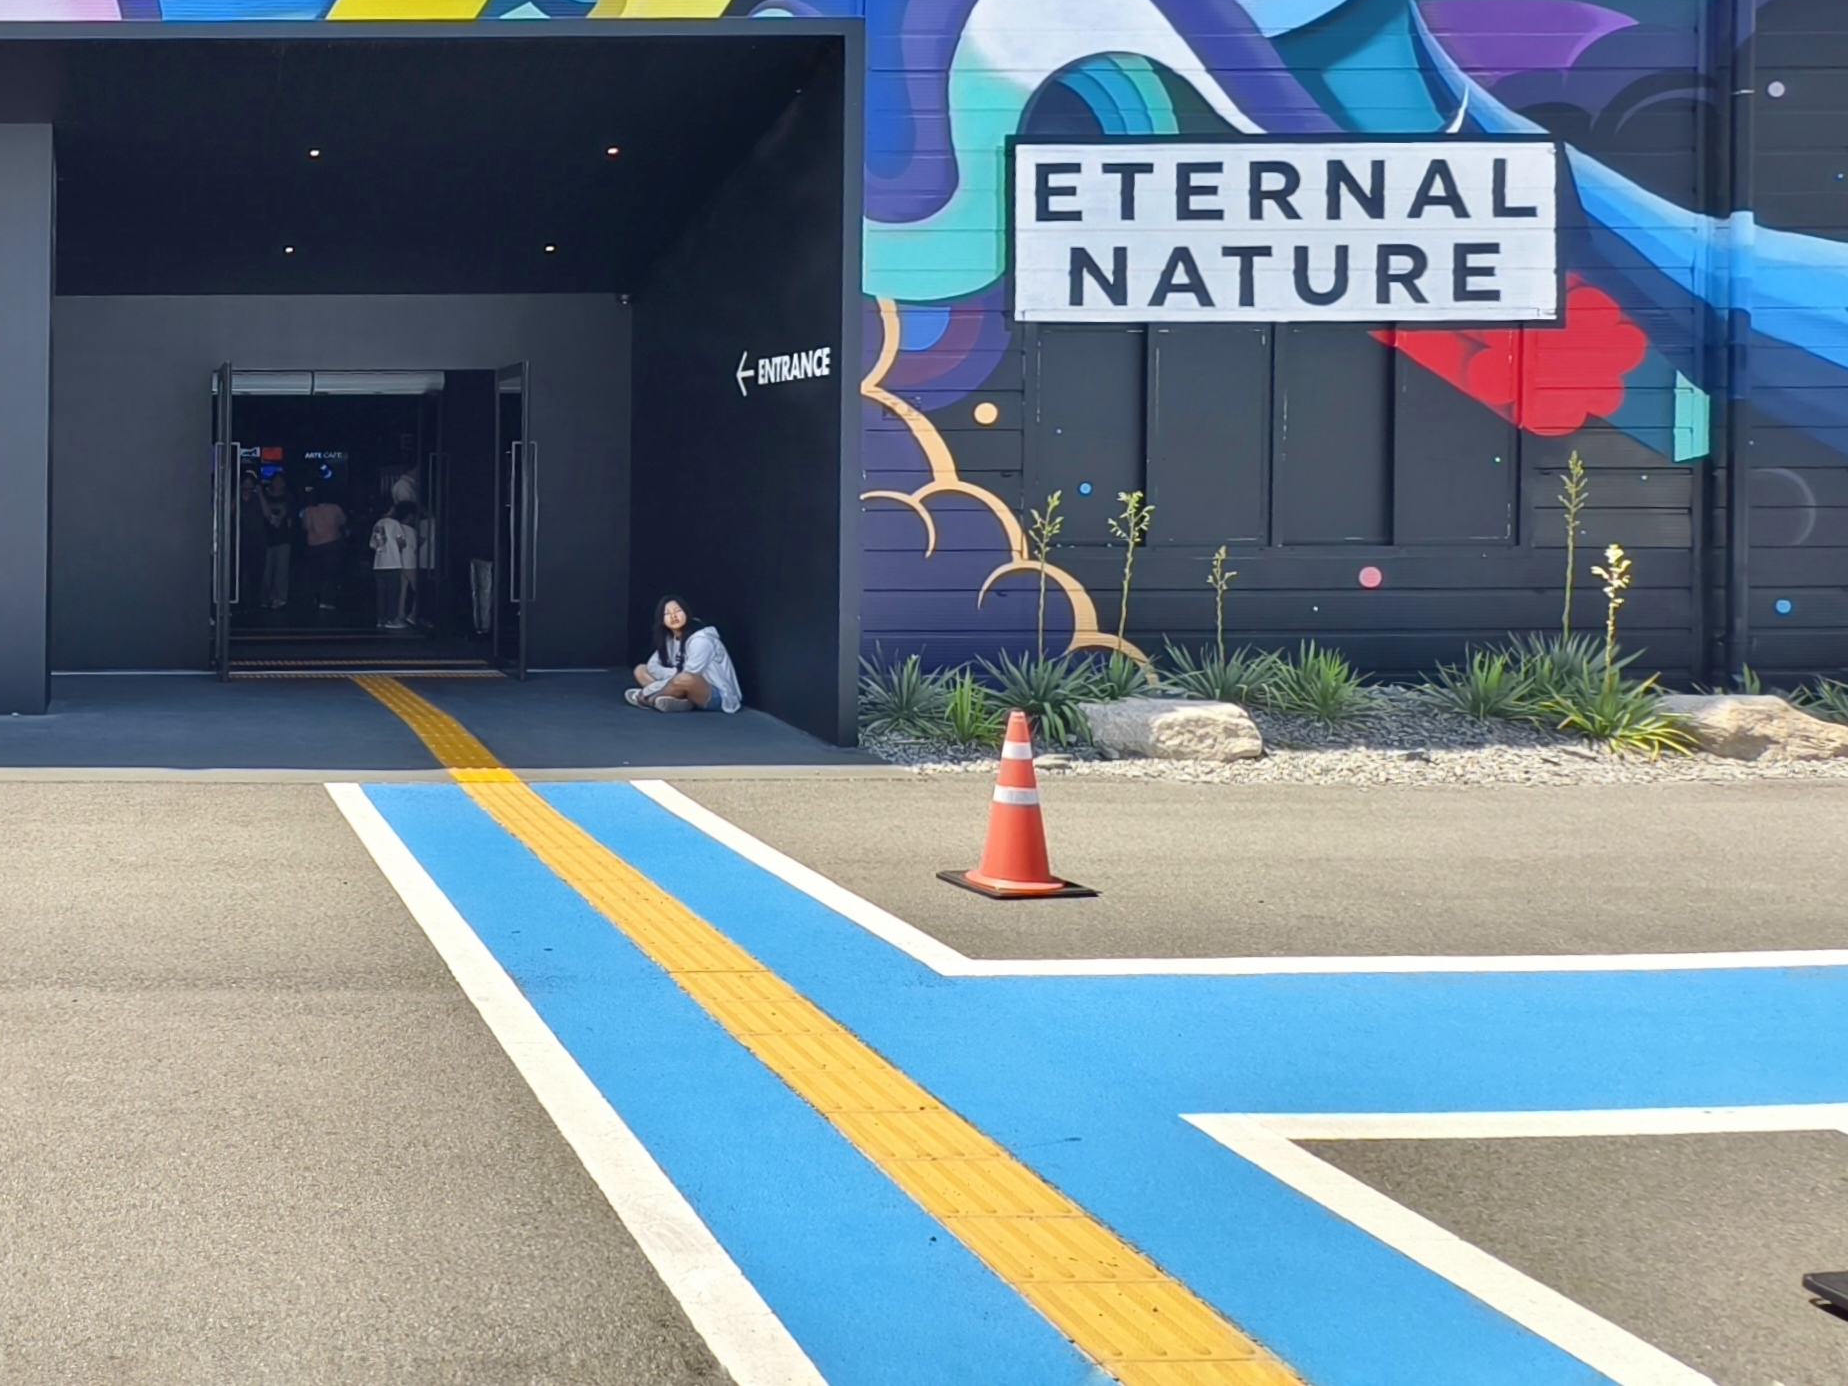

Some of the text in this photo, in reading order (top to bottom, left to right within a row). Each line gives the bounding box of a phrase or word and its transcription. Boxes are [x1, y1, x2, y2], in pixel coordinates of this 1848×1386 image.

[1034, 158, 1540, 222] ETERNAL
[1068, 242, 1501, 307] NATURE
[757, 347, 831, 385] ENTRANCE
